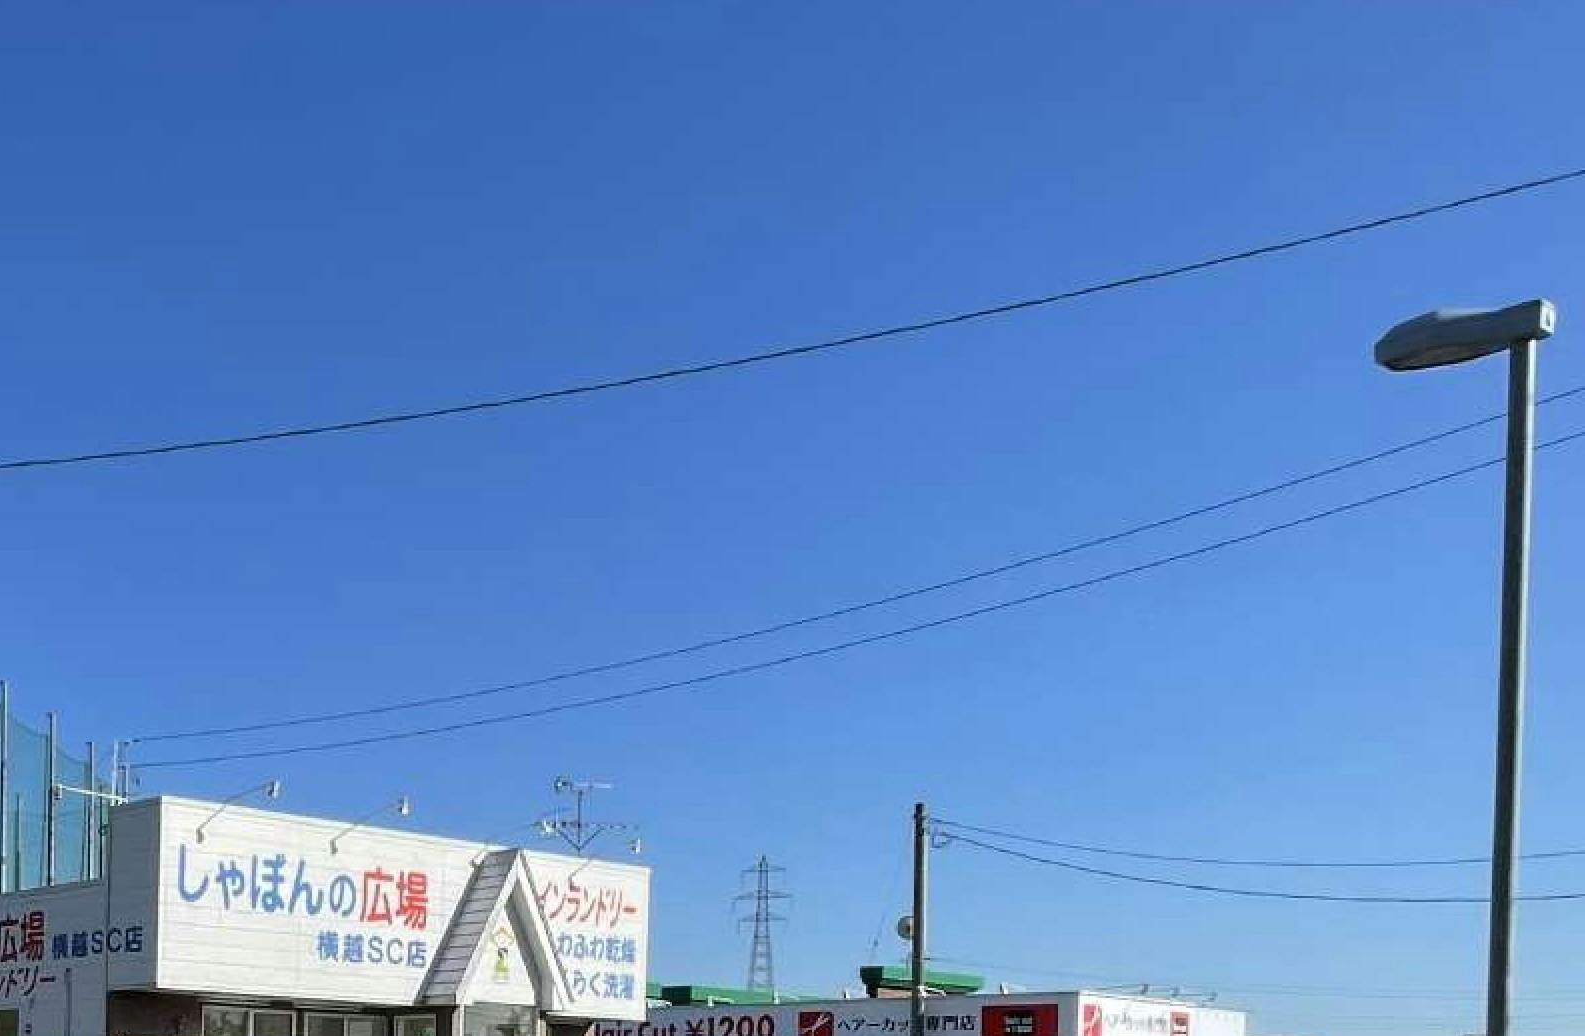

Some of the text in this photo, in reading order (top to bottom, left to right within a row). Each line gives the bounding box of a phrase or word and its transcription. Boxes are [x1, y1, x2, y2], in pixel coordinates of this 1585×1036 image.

[178, 842, 429, 930] しゃぼんの広場
[837, 1014, 976, 1032] ヘアーカッ専門店
